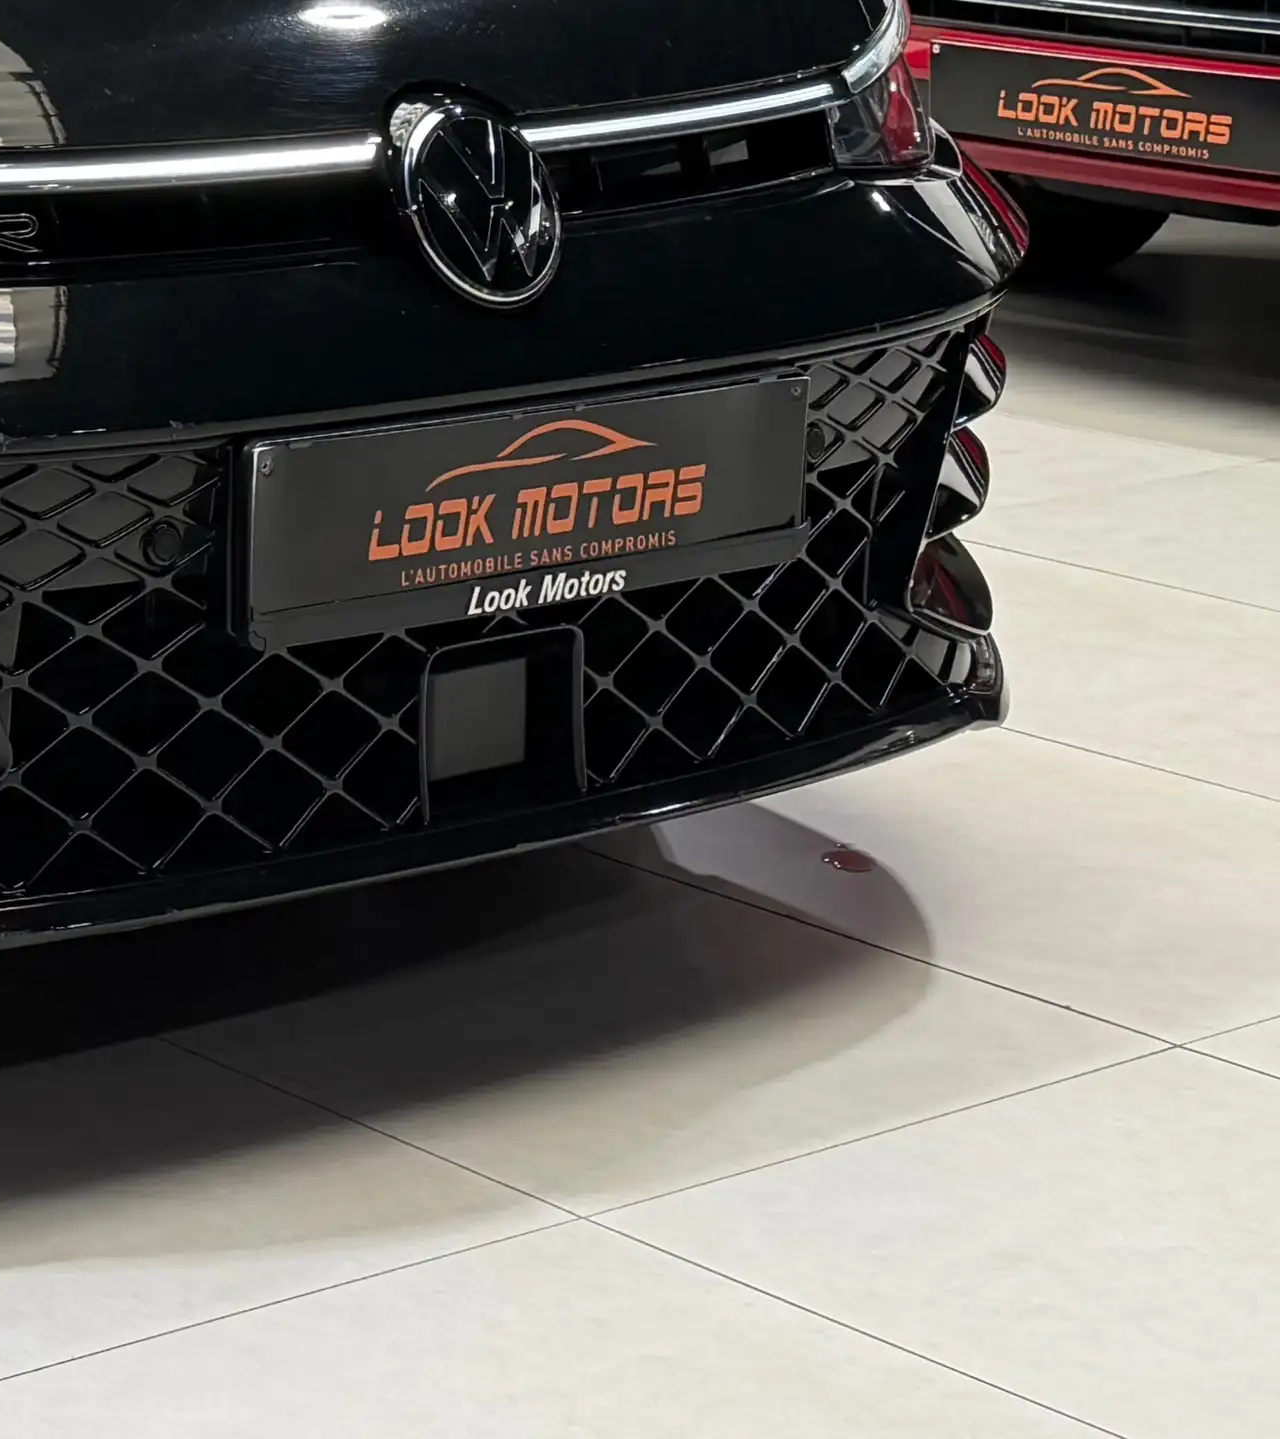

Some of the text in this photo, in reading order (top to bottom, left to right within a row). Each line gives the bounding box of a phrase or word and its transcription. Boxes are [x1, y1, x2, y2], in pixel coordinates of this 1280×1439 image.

[997, 89, 1233, 145] LOOK MOTORS
[1017, 126, 1210, 160] L'AUTOMOBILE SANS COMPROMIS
[368, 463, 707, 561] LOOK MOTORS
[400, 529, 678, 588] L'AUTOMOBILE SANS COMPROMIS
[466, 568, 628, 616] Look Motors
